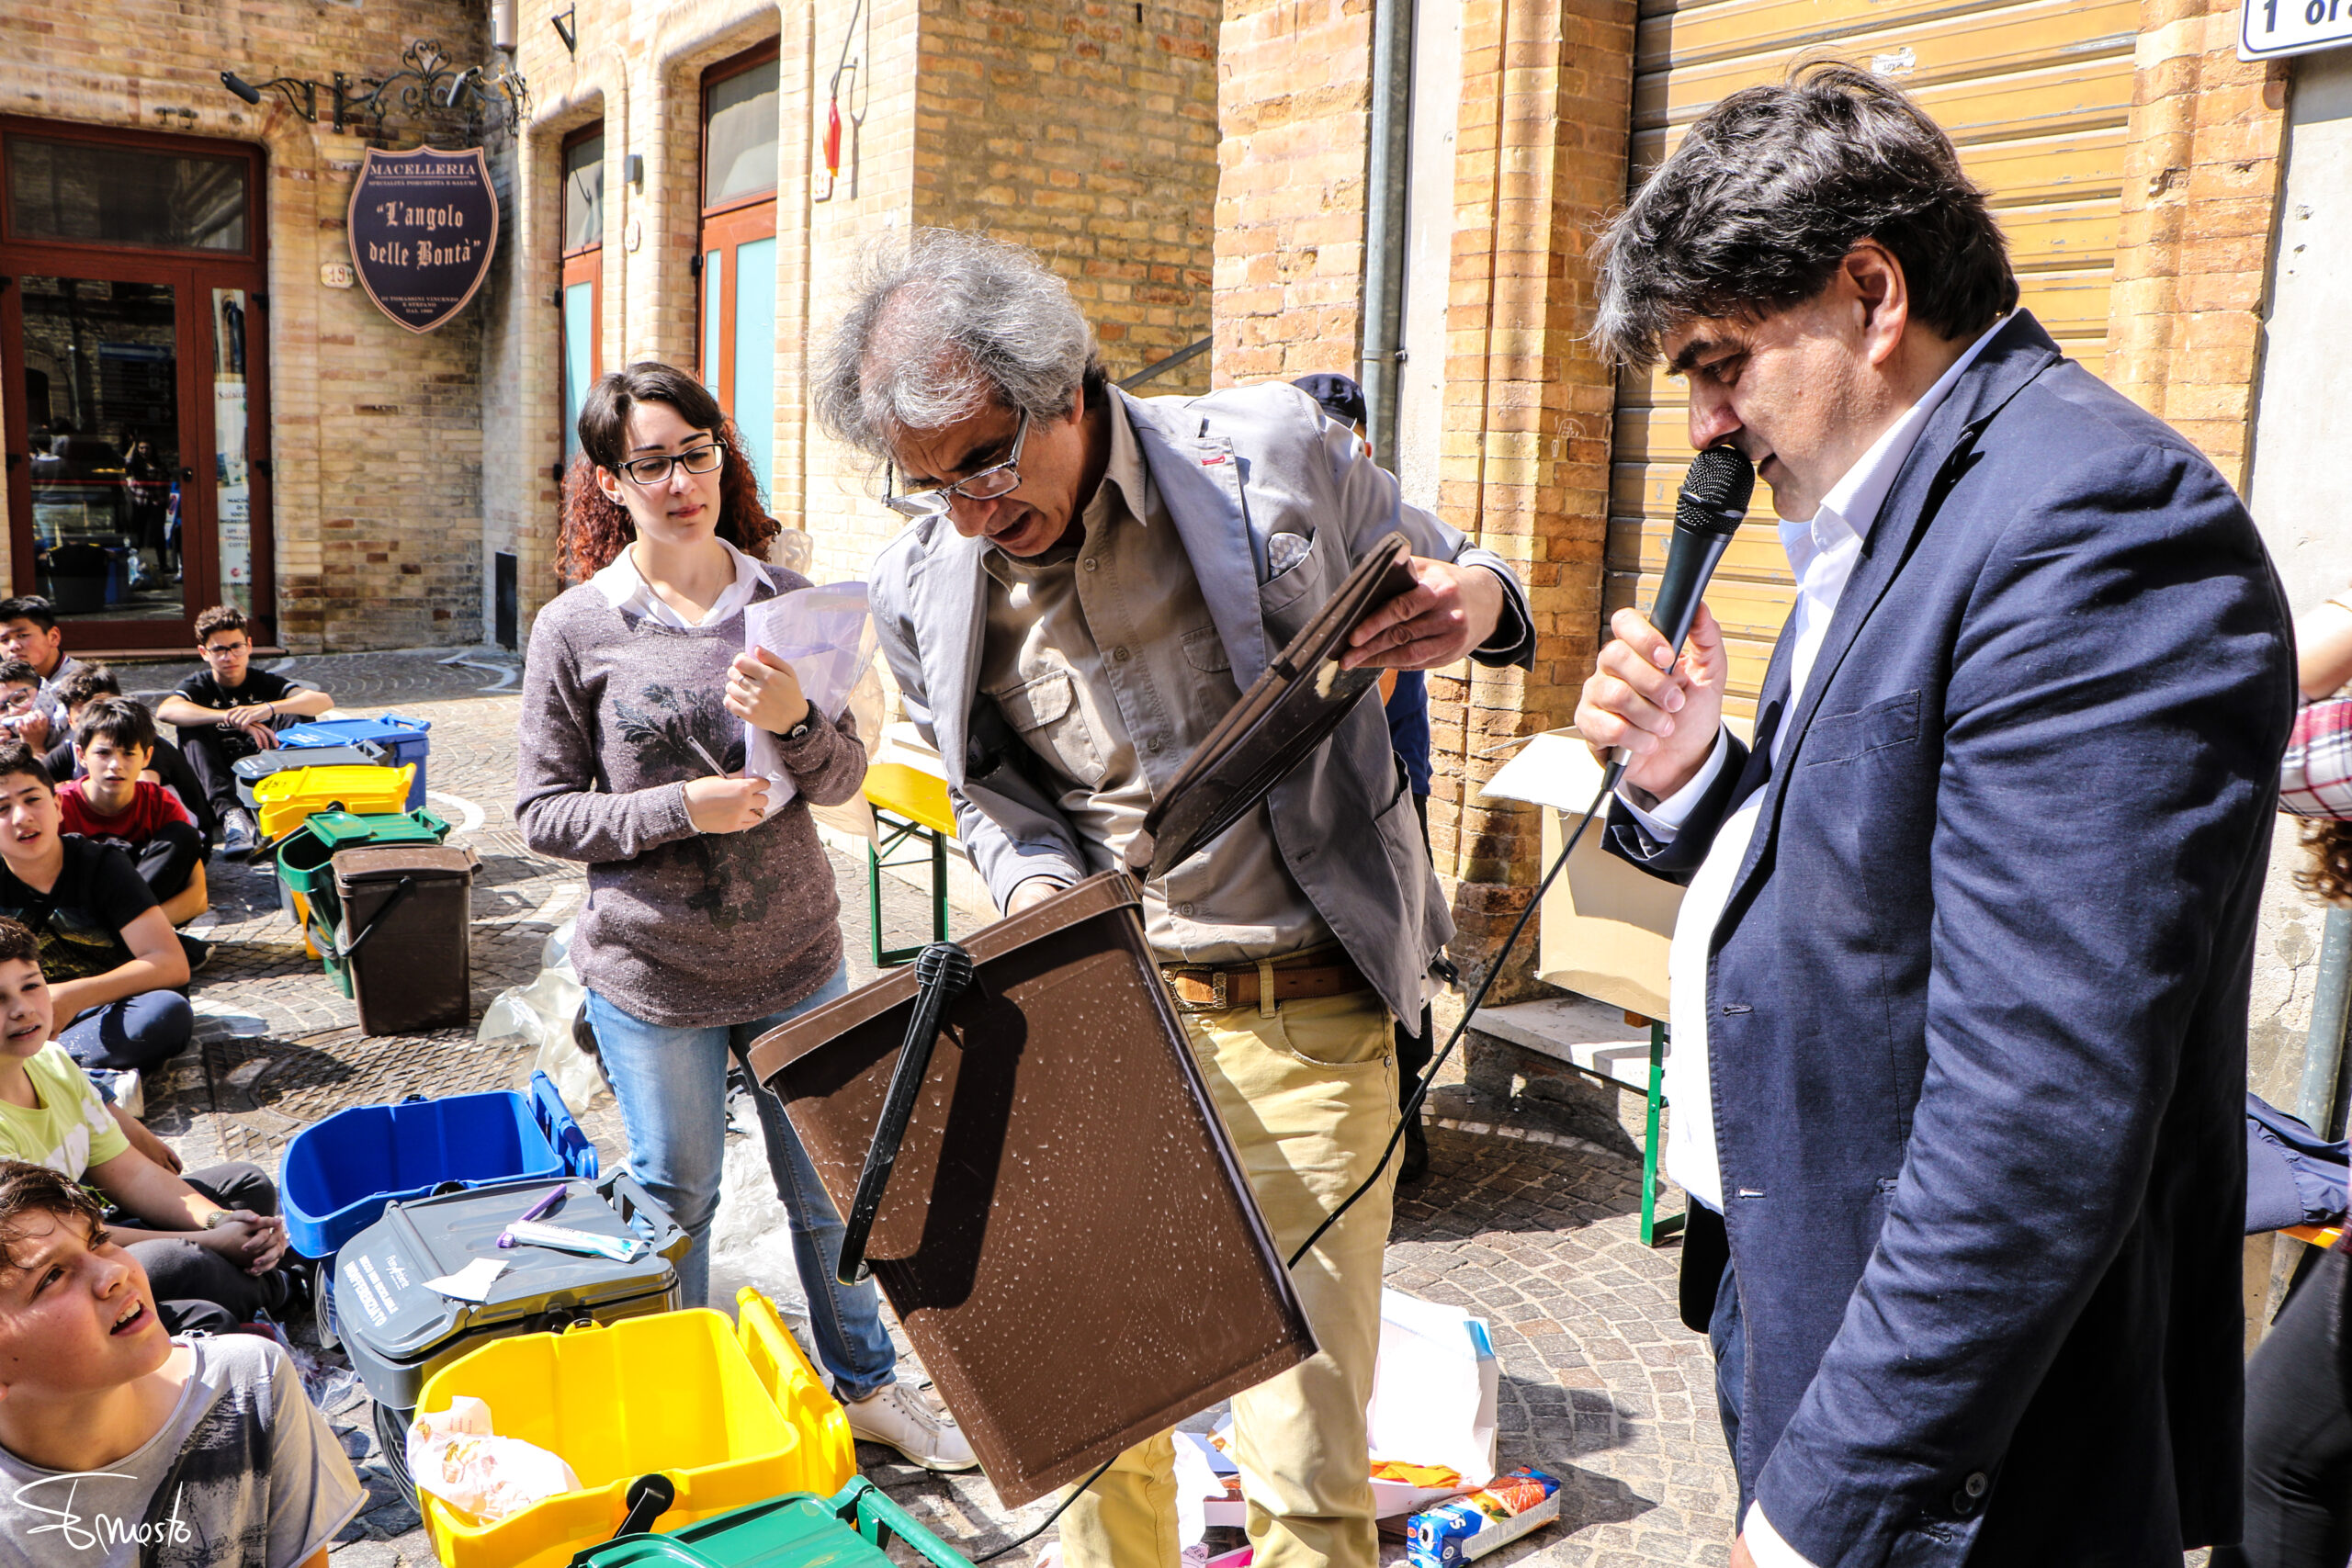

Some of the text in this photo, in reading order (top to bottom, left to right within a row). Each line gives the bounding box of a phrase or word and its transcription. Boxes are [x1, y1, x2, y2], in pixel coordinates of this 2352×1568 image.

[2305, 0, 2352, 25] or
[369, 164, 477, 175] MACELLERIA
[369, 241, 410, 266] delle
[343, 1260, 388, 1327] INDIFFERENZIATO
